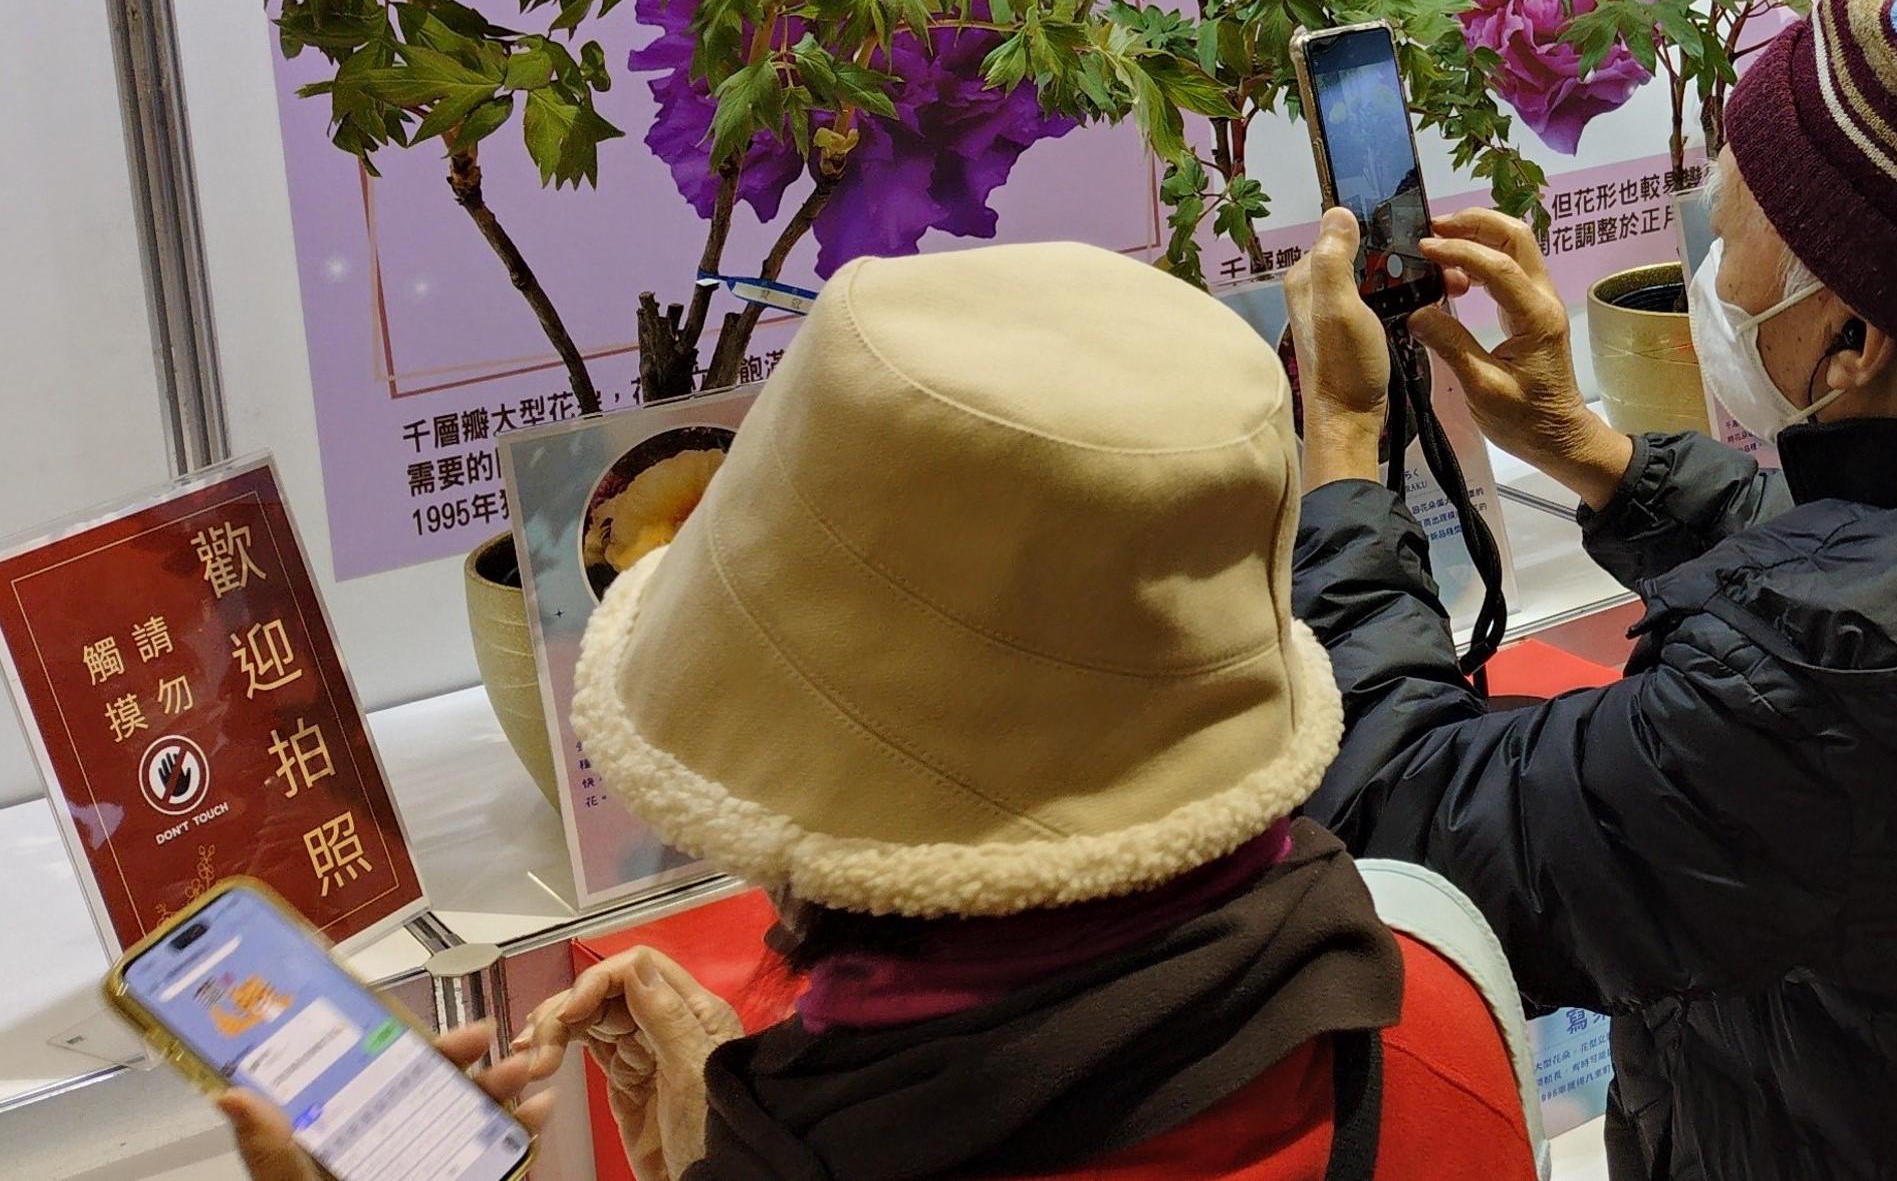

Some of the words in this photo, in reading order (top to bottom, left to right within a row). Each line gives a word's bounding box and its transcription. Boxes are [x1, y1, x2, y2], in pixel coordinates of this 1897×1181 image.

[406, 446, 502, 498] 需要的
[81, 634, 149, 743] 觸摸
[130, 614, 193, 716] 請勿
[190, 521, 373, 898] 歡迎拍照
[155, 820, 190, 846] DON'T
[192, 802, 230, 828] TOUCH
